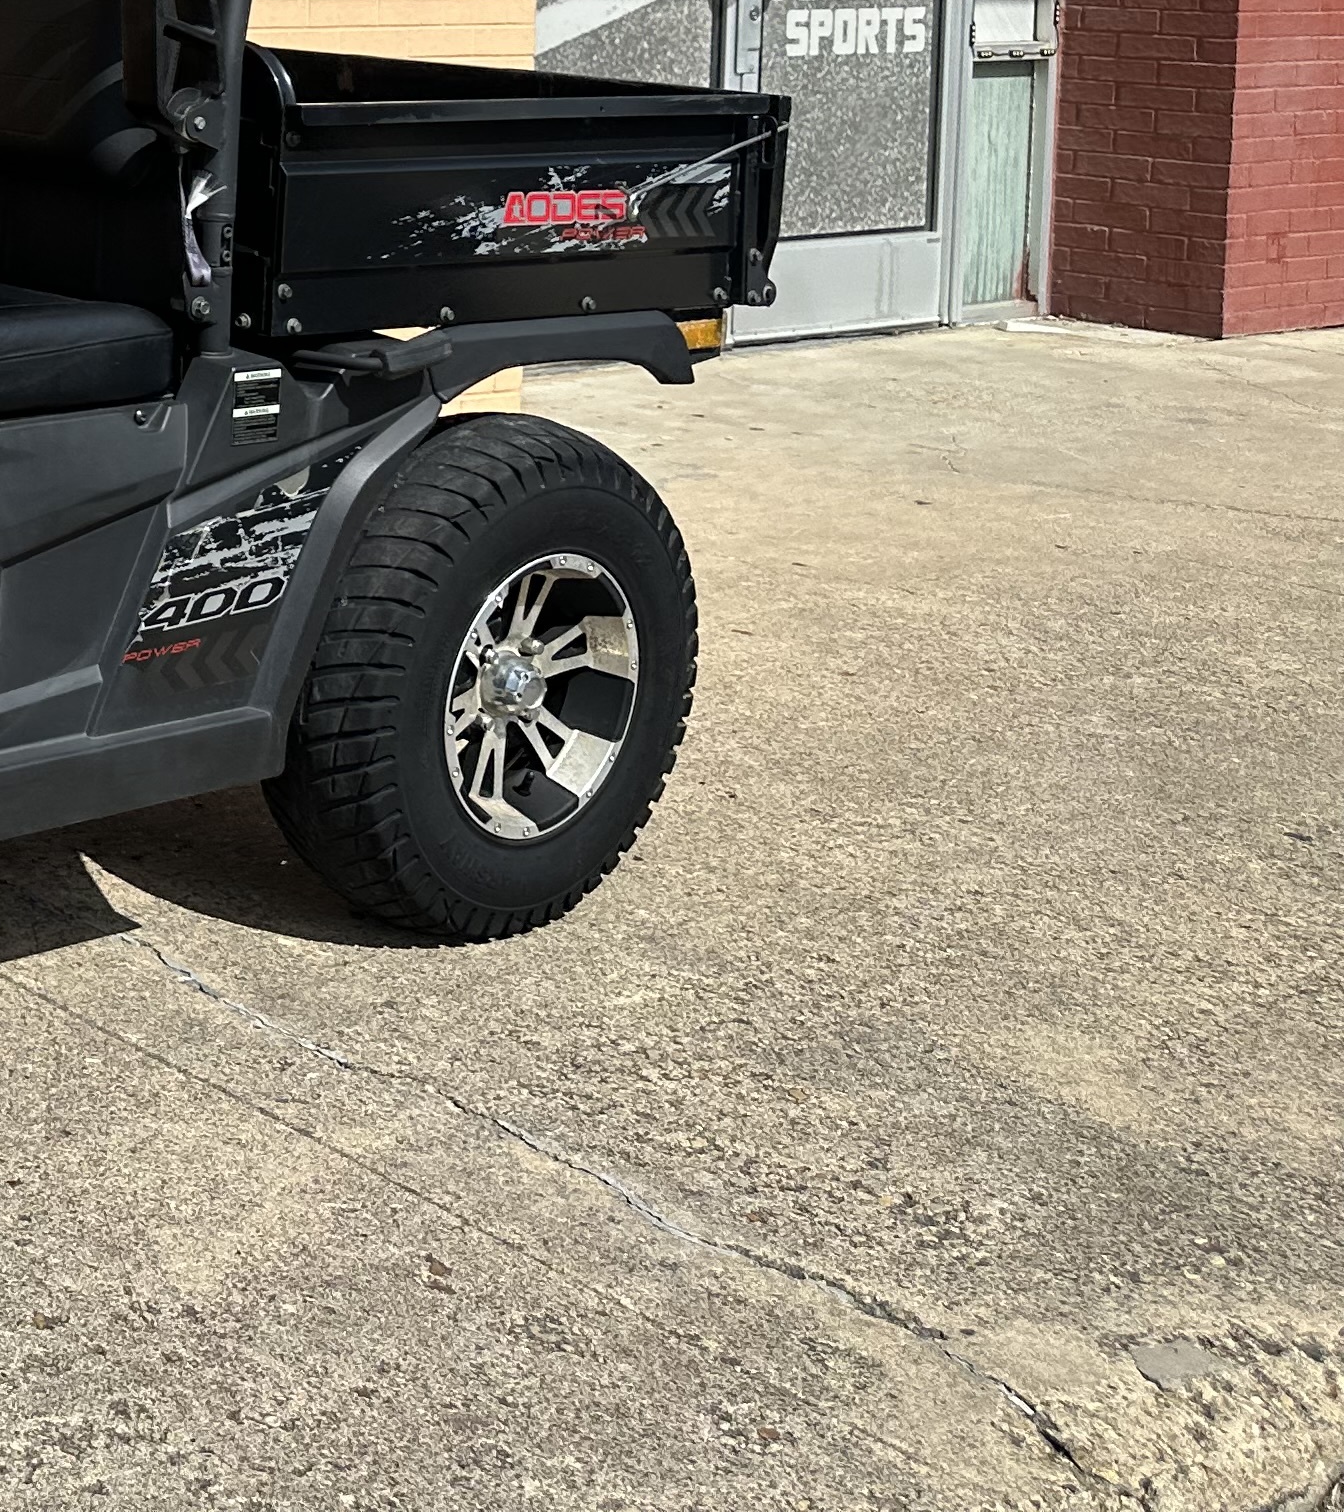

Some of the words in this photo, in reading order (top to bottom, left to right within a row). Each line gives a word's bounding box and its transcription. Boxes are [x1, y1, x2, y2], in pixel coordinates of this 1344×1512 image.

[786, 7, 926, 57] SPORTS
[503, 190, 628, 226] AODES
[138, 576, 288, 631] 400
[122, 638, 202, 665] POWER
